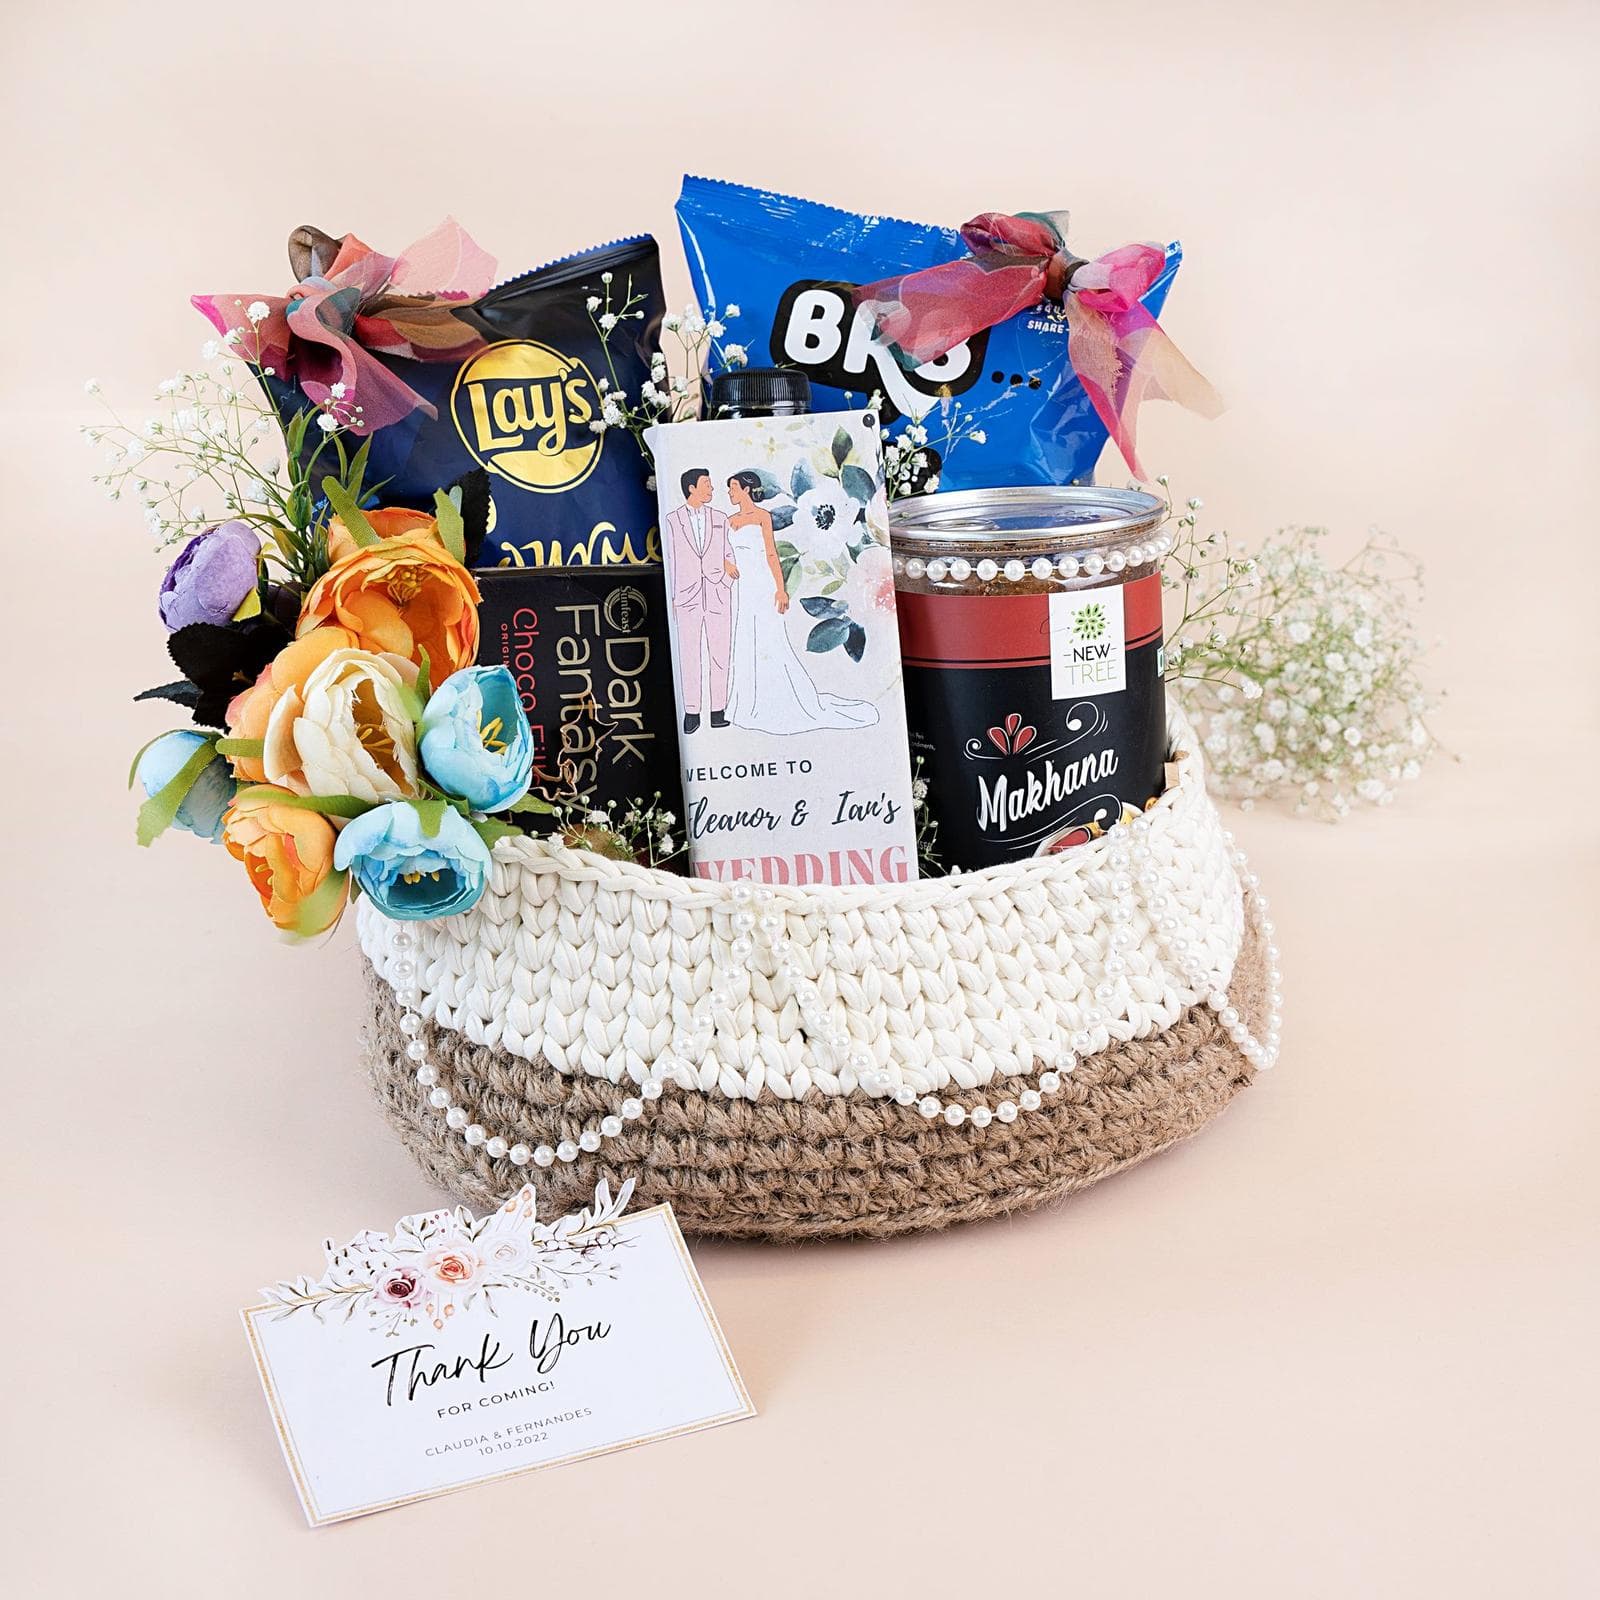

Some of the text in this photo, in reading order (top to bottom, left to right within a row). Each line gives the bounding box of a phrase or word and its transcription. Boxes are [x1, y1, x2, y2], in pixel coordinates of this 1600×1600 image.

[467, 367, 593, 456] Lay's
[512, 607, 540, 712] Choco
[1063, 663, 1118, 685] TREE
[1073, 645, 1111, 663] NEW
[554, 603, 603, 815] Fantasy
[604, 637, 656, 765] Dark
[786, 759, 812, 775] TO
[976, 748, 1119, 832] Makhana
[790, 800, 809, 827] &
[831, 790, 902, 826] Ian's
[371, 1312, 612, 1407] Thank You
[437, 1380, 556, 1419] FOR COMING!
[425, 1407, 593, 1457] CLAUDIA & FERNANDES
[478, 1431, 549, 1456] 10.10.2022
